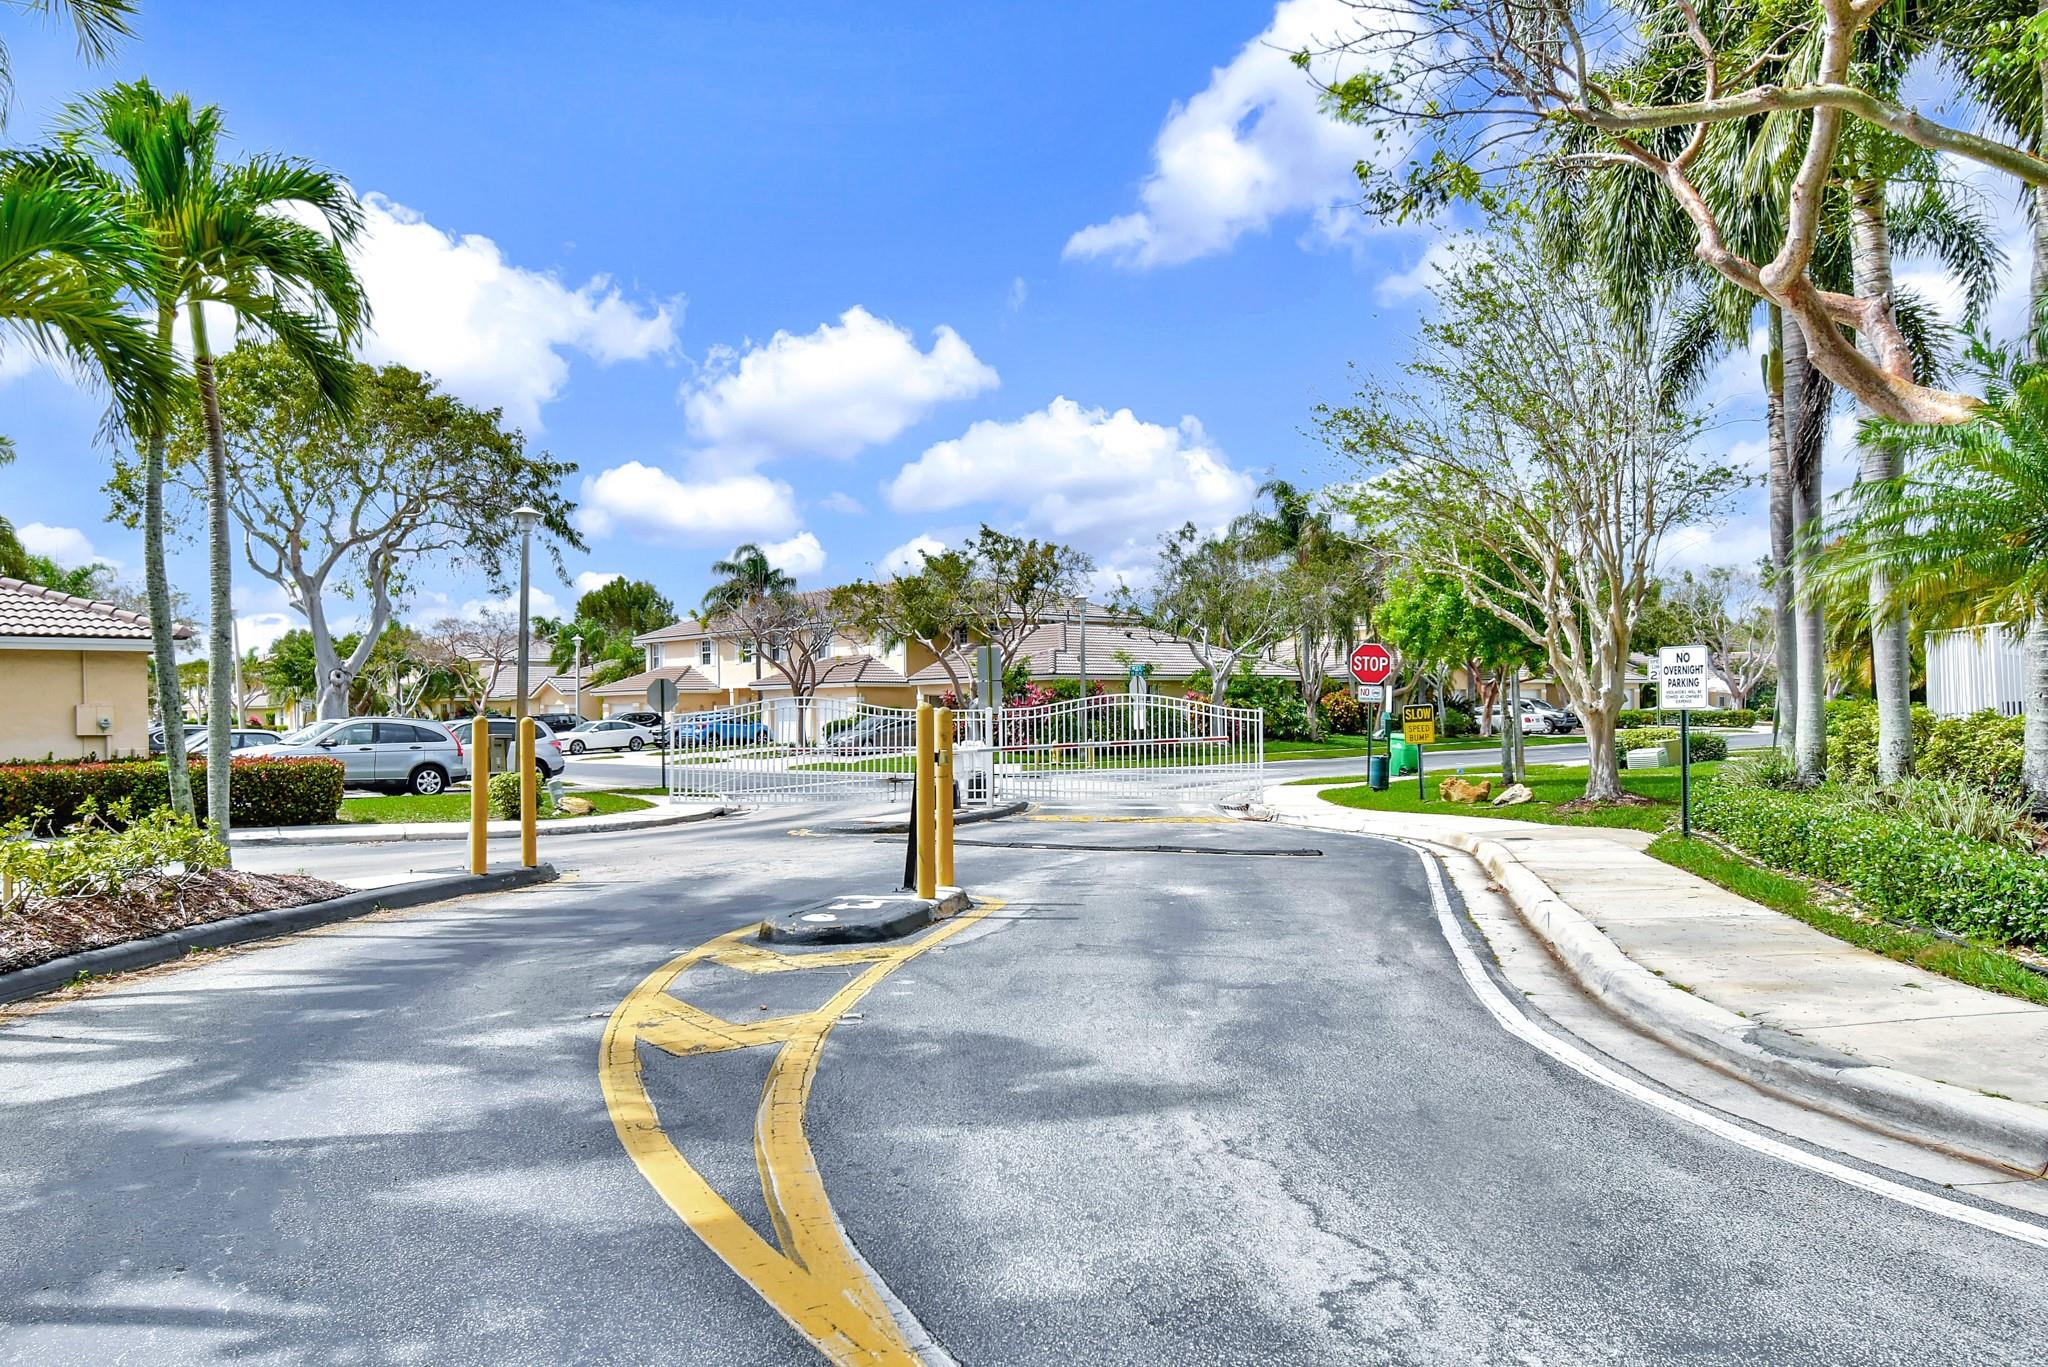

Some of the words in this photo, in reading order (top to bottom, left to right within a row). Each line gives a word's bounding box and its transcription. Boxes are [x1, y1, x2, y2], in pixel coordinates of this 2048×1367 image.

[1676, 652, 1690, 663] NO
[1353, 655, 1389, 672] STOP
[1663, 665, 1704, 675] OVERNIGHT
[1668, 678, 1700, 688] PARKING
[1360, 688, 1370, 697] NO
[1405, 707, 1431, 720] SLOW
[1408, 724, 1430, 733] SPEED
[1409, 733, 1430, 742] BUMP
